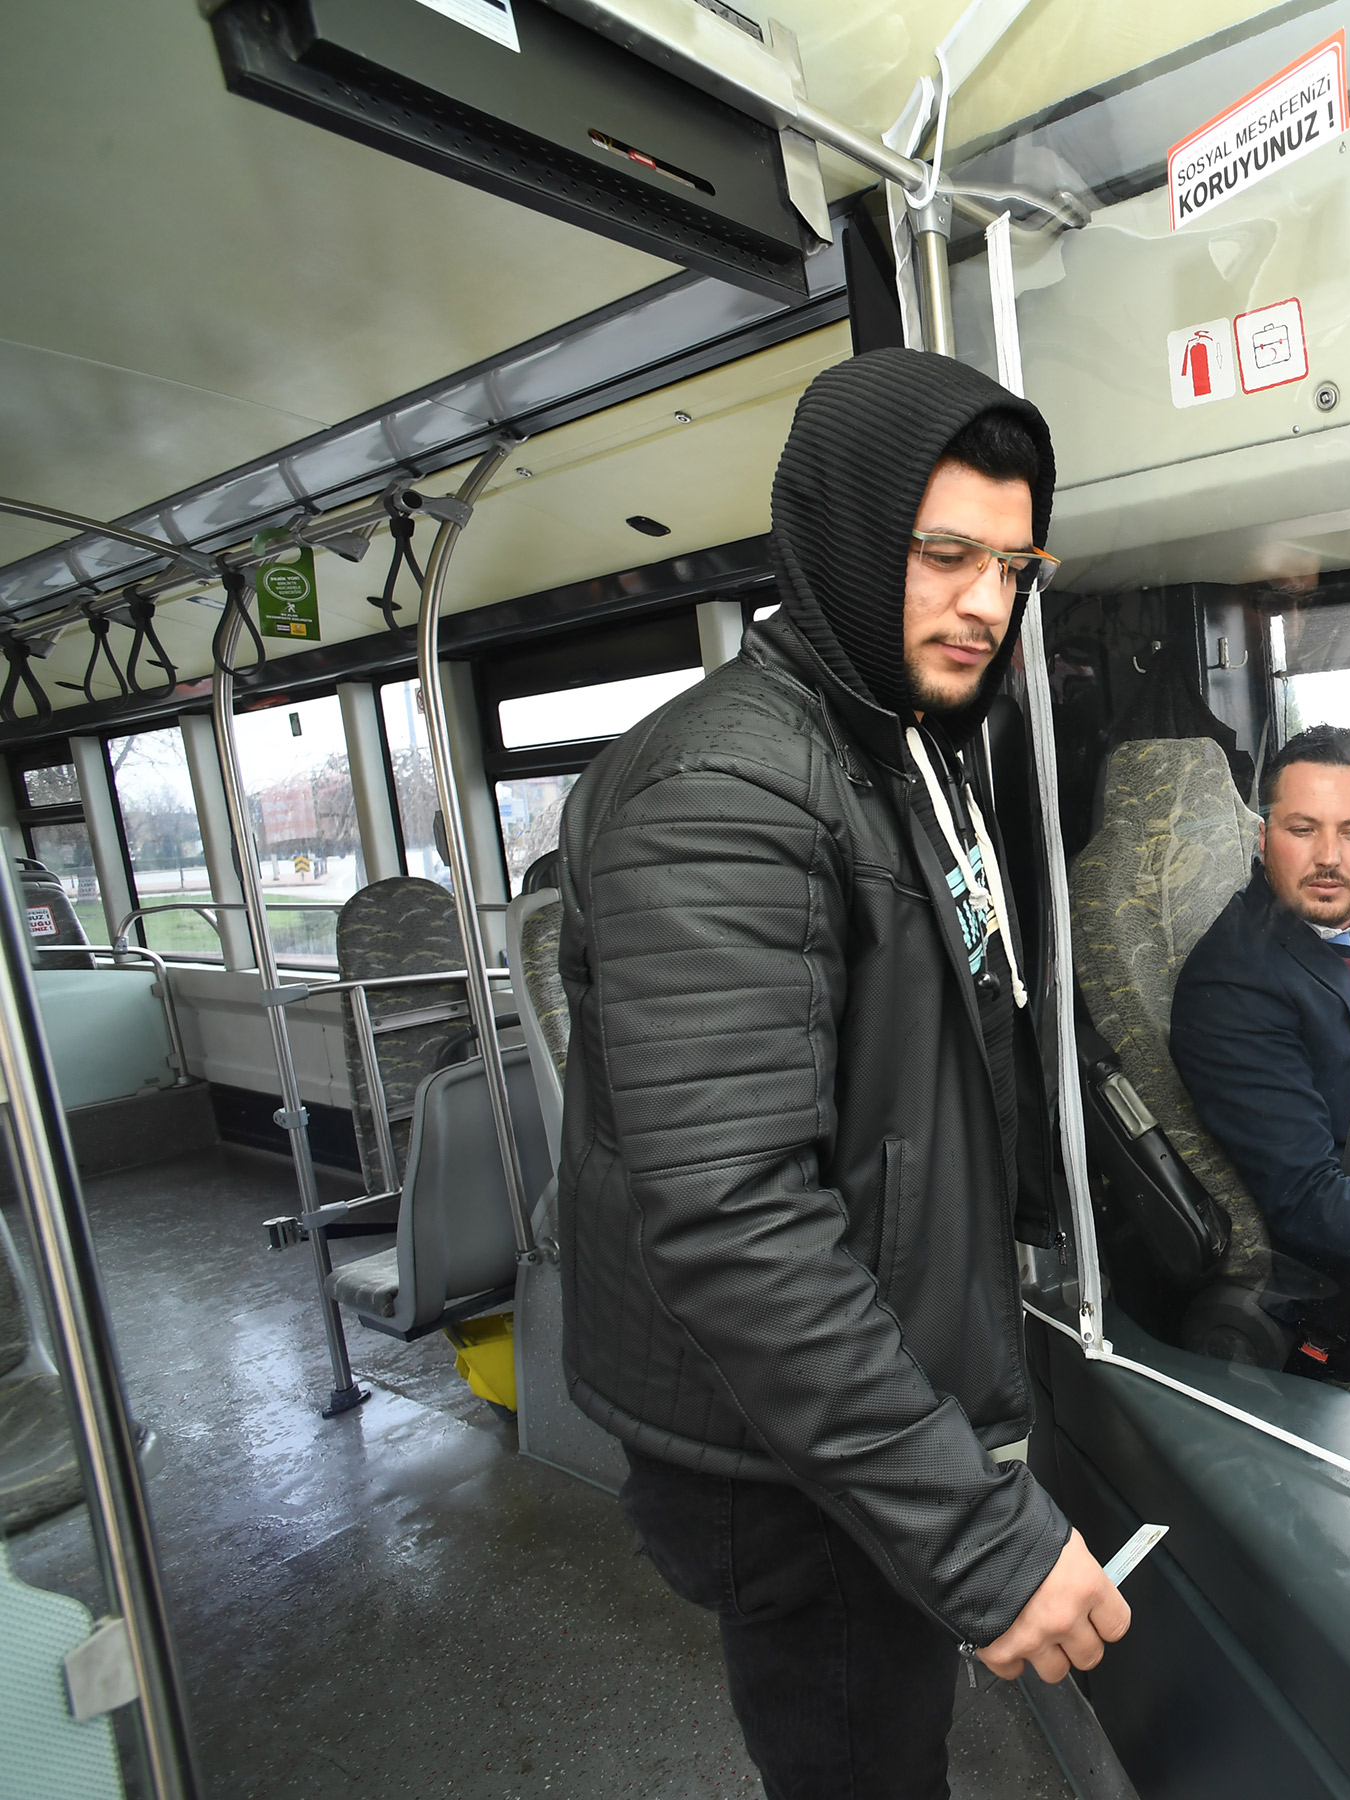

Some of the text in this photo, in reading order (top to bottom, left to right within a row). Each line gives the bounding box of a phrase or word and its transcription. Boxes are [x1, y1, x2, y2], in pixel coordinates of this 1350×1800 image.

[1178, 141, 1232, 187] SOSYAL
[1179, 110, 1320, 218] KORUYUNUZ
[1327, 101, 1335, 128] !
